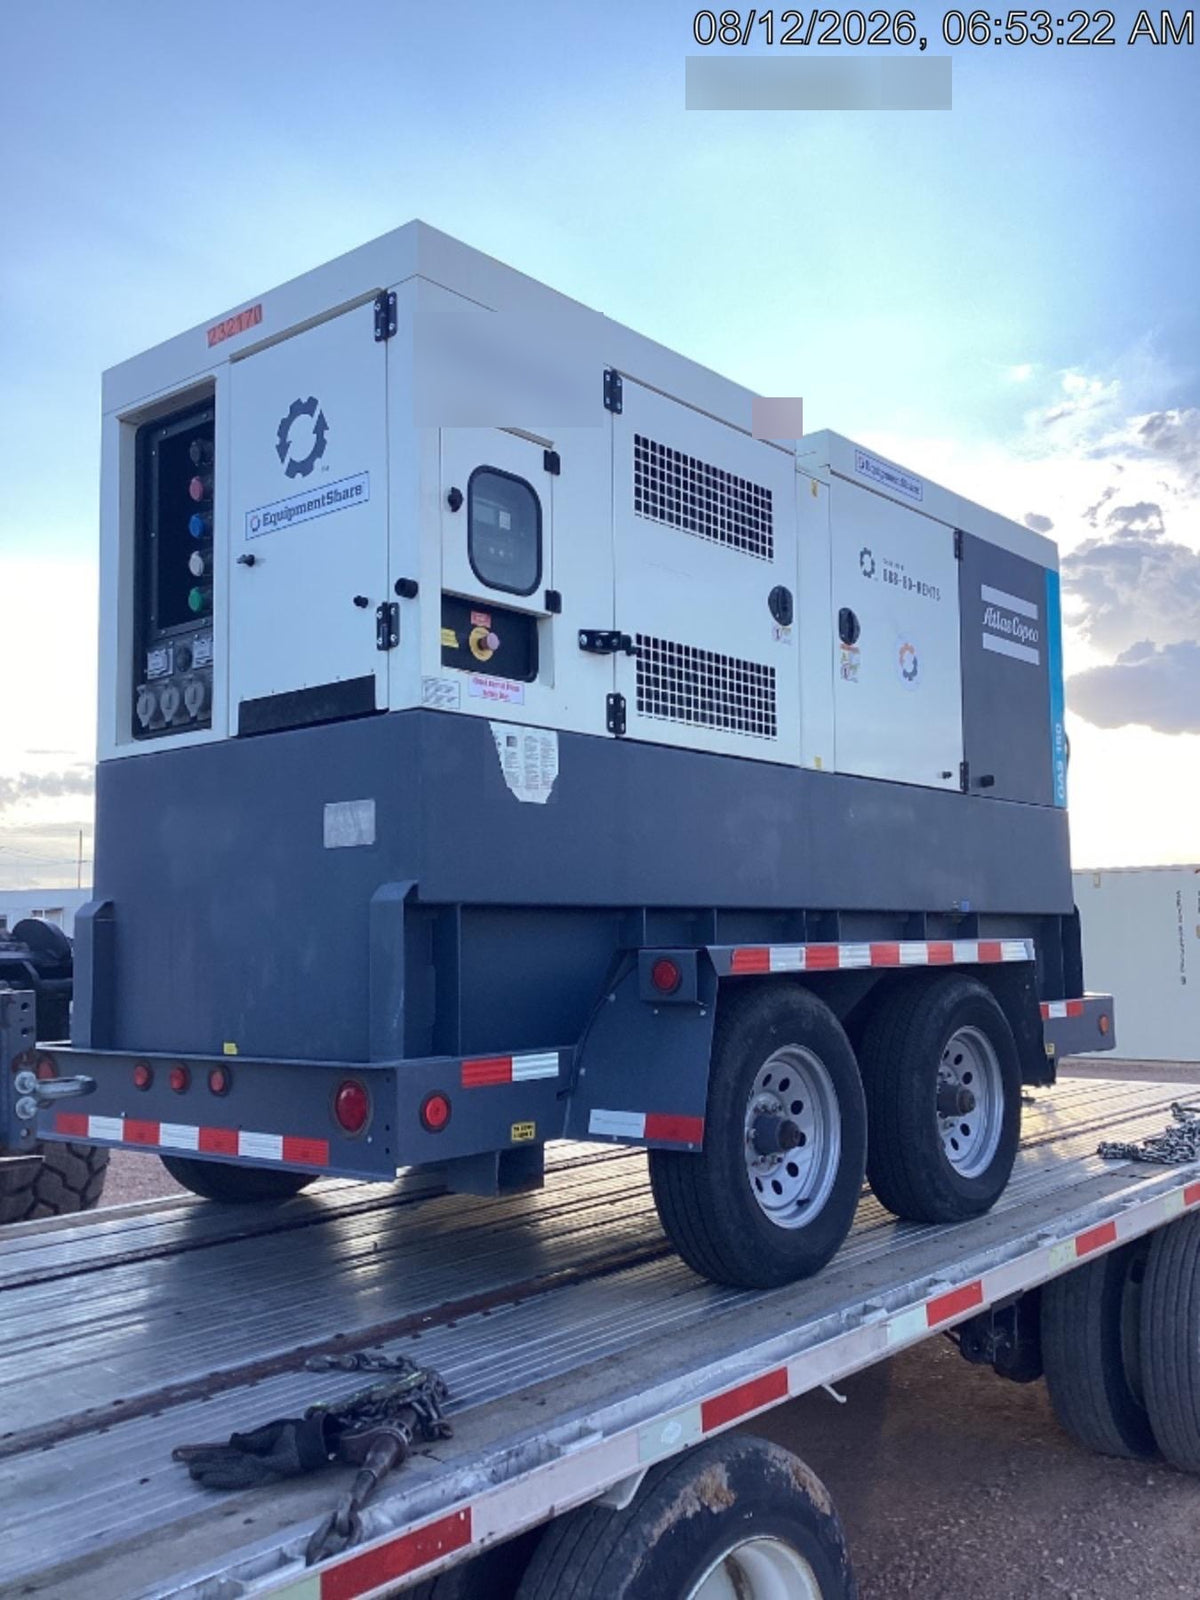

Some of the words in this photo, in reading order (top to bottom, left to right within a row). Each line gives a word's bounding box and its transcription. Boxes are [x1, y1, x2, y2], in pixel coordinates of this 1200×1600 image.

[262, 484, 363, 526] EquipmentShare
[982, 607, 1012, 634] Atlas
[1012, 616, 1039, 643] Copco
